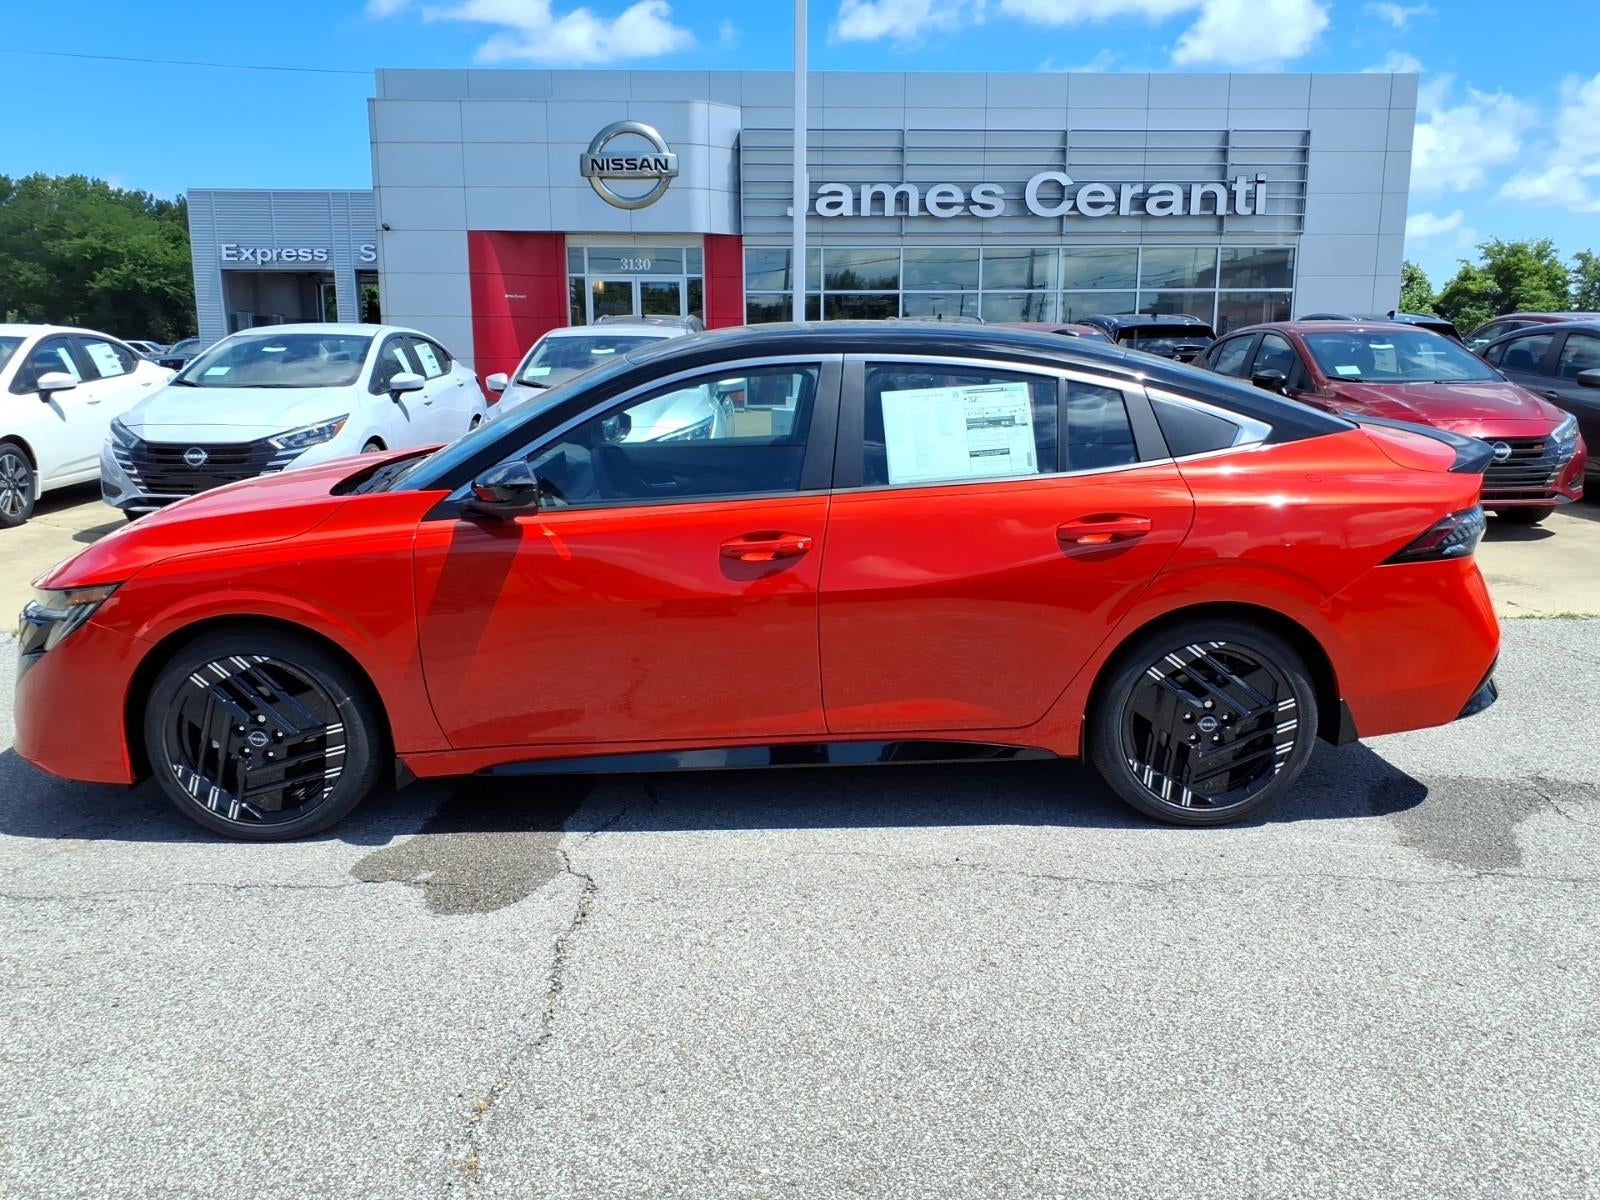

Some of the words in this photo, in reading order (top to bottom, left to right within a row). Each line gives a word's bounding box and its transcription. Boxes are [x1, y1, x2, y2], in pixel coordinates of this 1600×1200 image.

[590, 158, 669, 172] NISSAN
[1025, 170, 1268, 217] Ceranti
[221, 243, 328, 265] Express
[620, 257, 651, 271] 3130
